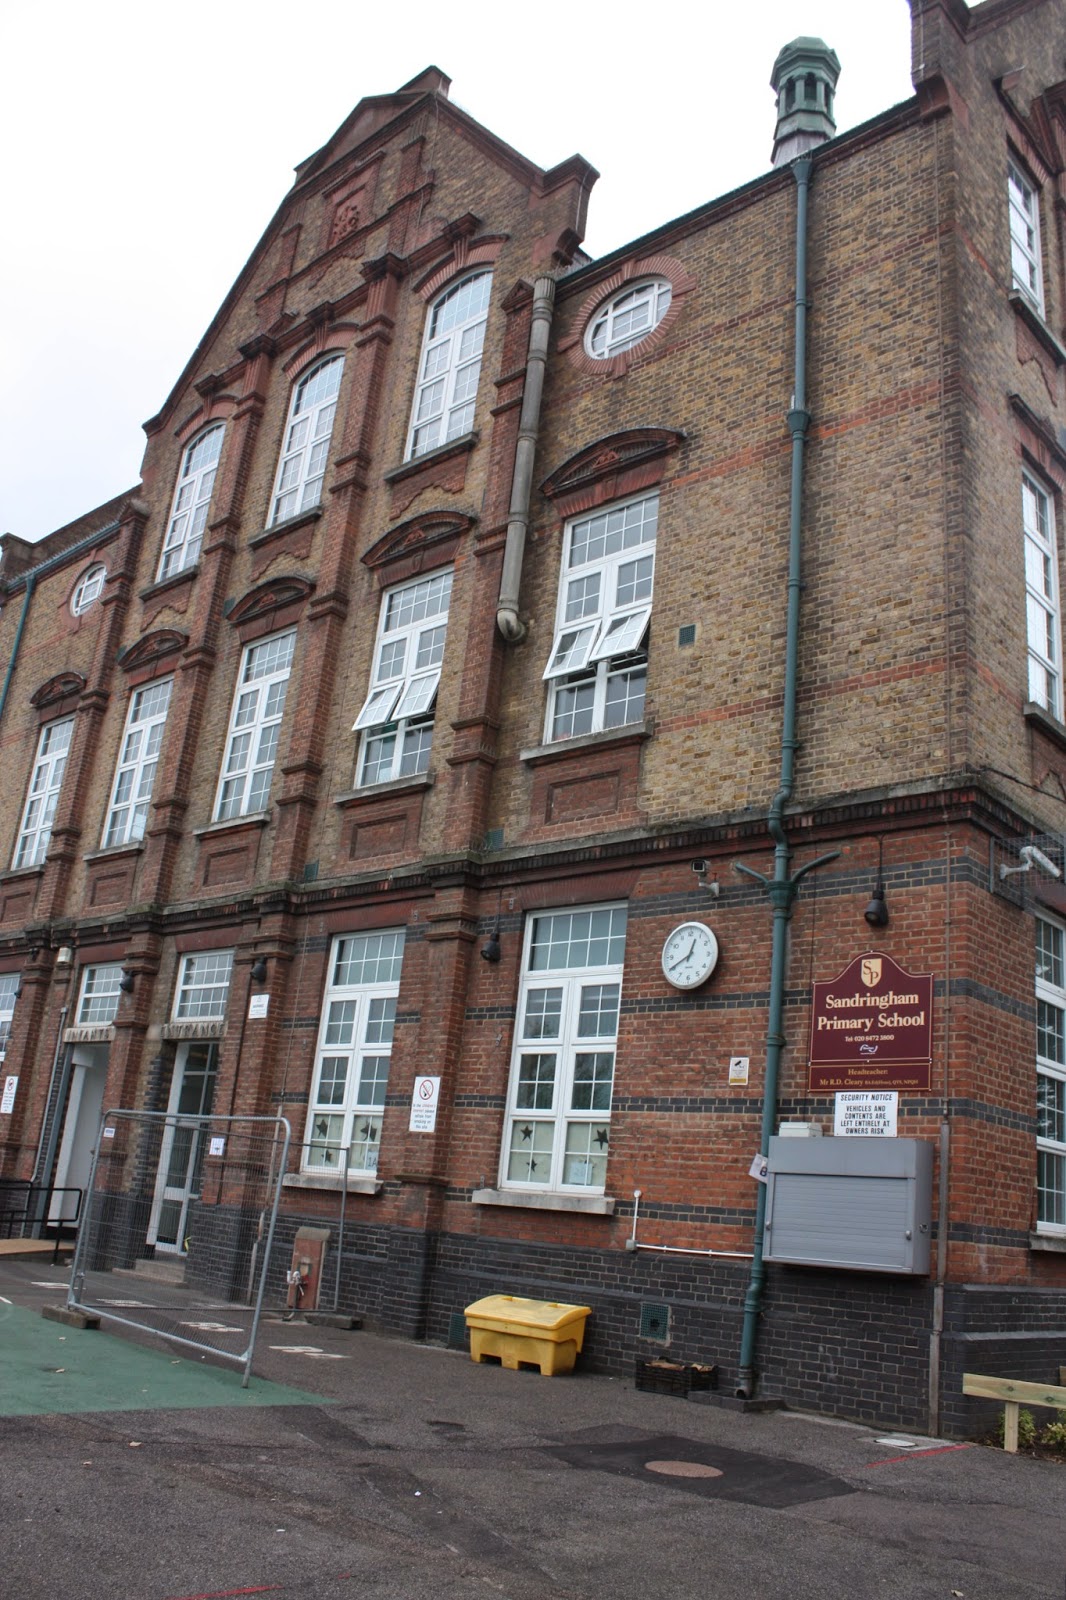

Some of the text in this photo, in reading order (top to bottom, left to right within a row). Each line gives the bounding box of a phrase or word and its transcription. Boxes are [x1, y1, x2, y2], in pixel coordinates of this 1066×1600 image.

[826, 991, 919, 1010] Sandringham
[818, 1011, 925, 1032] Primary School
[66, 1028, 108, 1041] INFANTS
[160, 1023, 224, 1038] ENTRANCE
